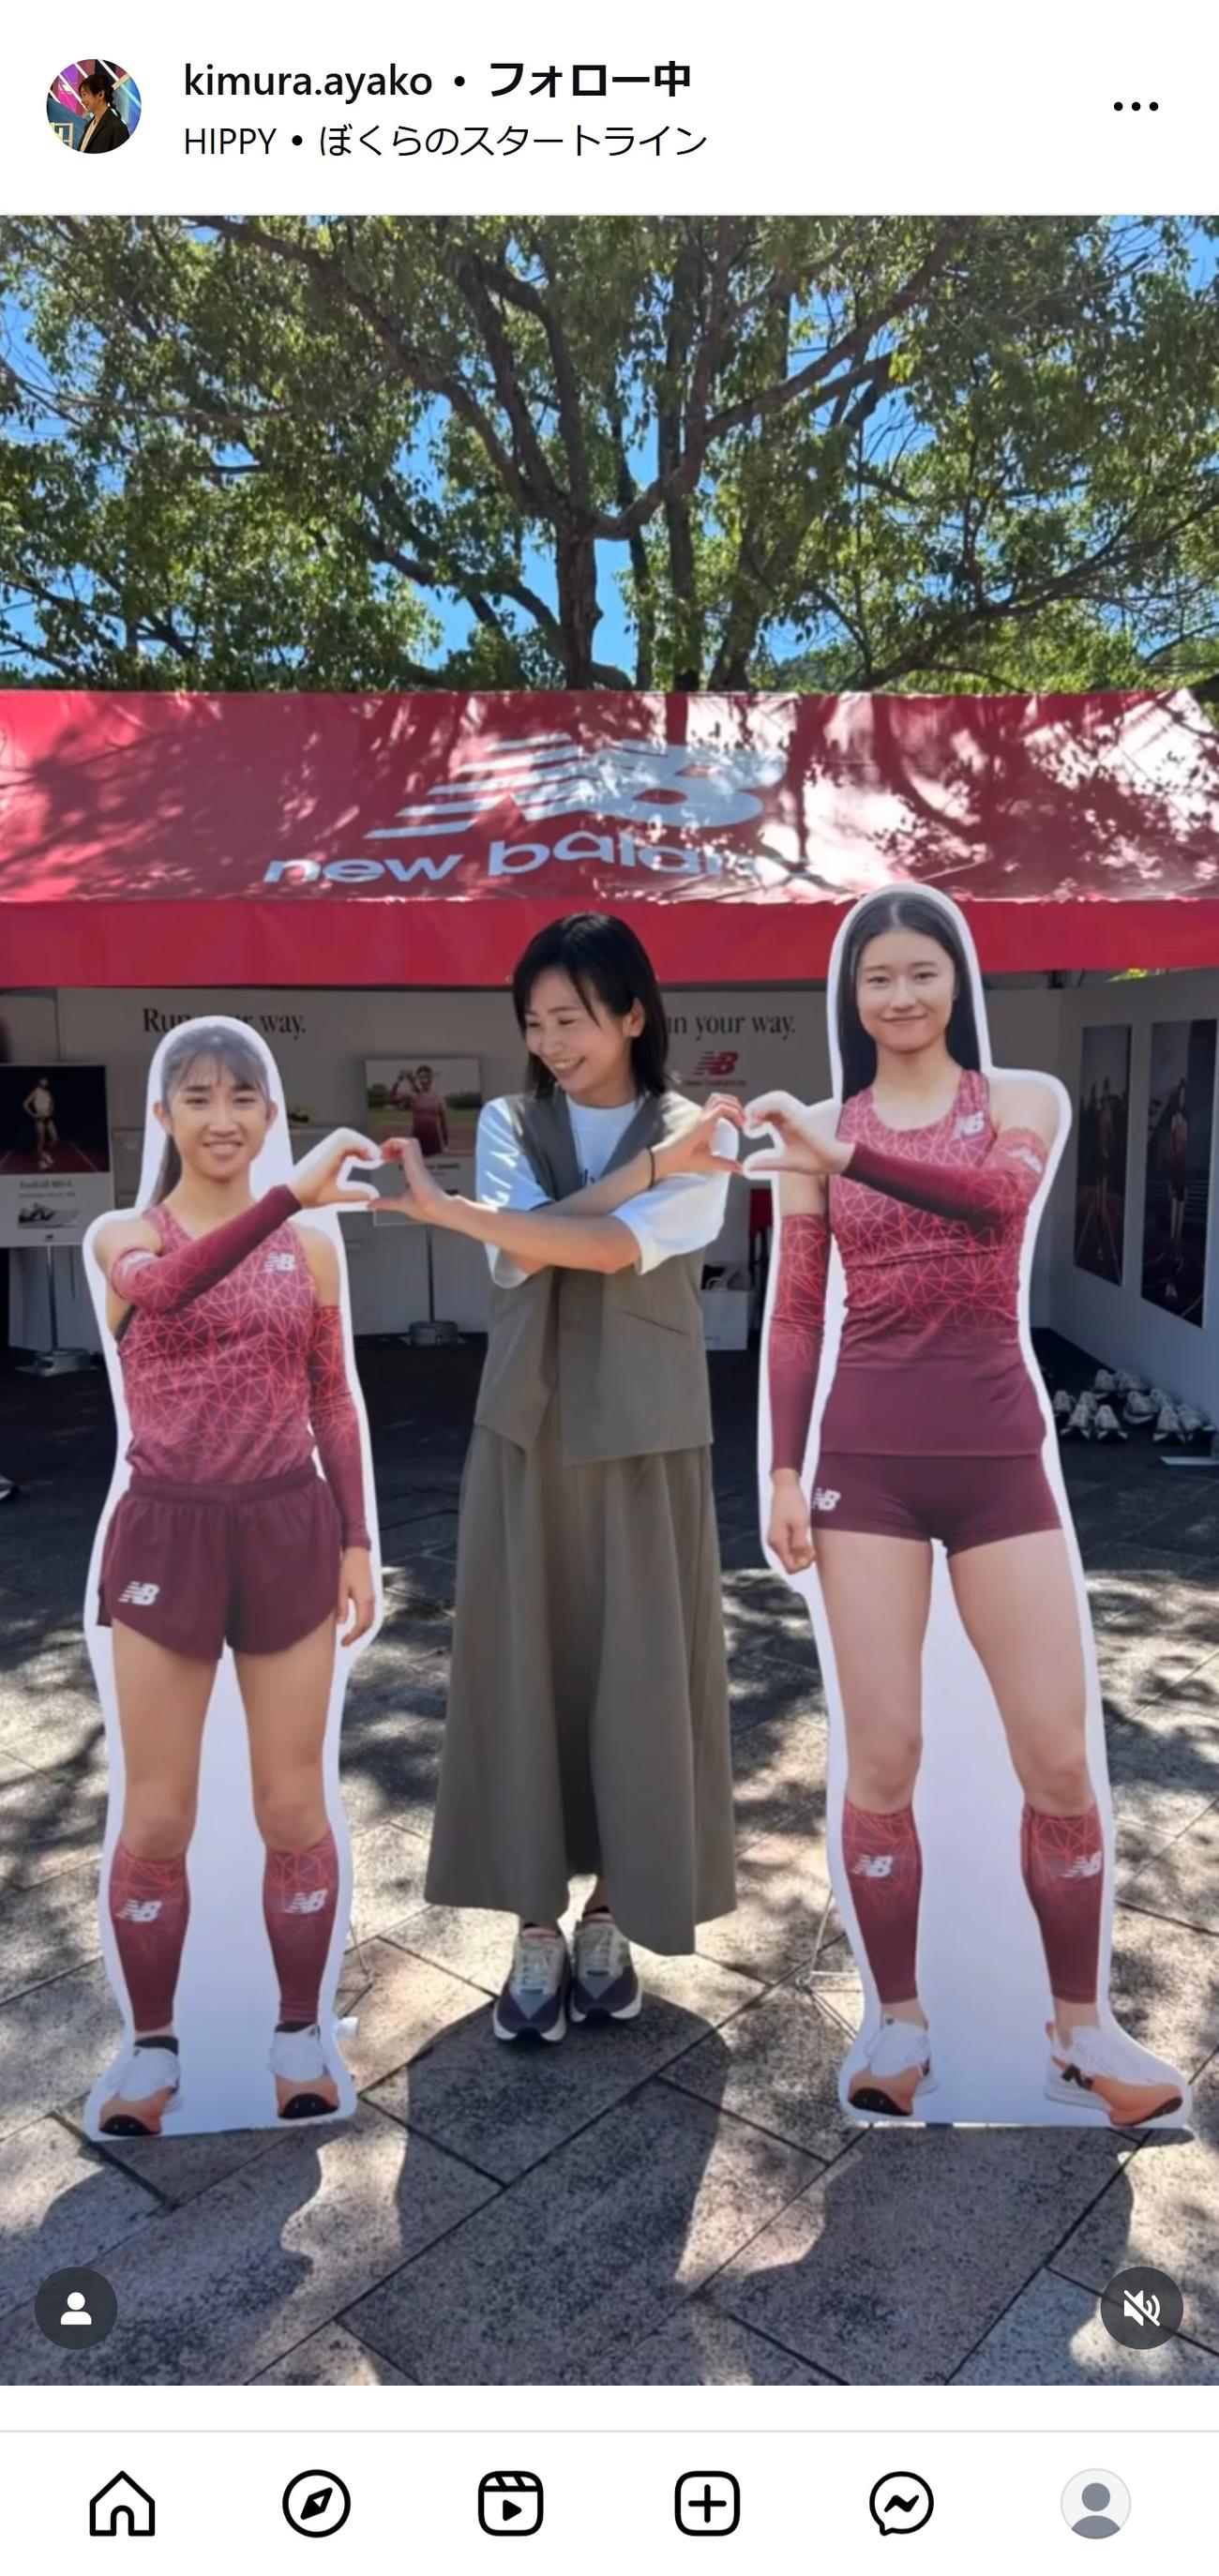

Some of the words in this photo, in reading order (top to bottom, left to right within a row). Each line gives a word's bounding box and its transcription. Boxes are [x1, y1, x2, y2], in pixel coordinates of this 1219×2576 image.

[263, 853, 463, 883] new
[260, 1015, 306, 1041] way.
[695, 1015, 746, 1041] your
[751, 1015, 795, 1041] way.
